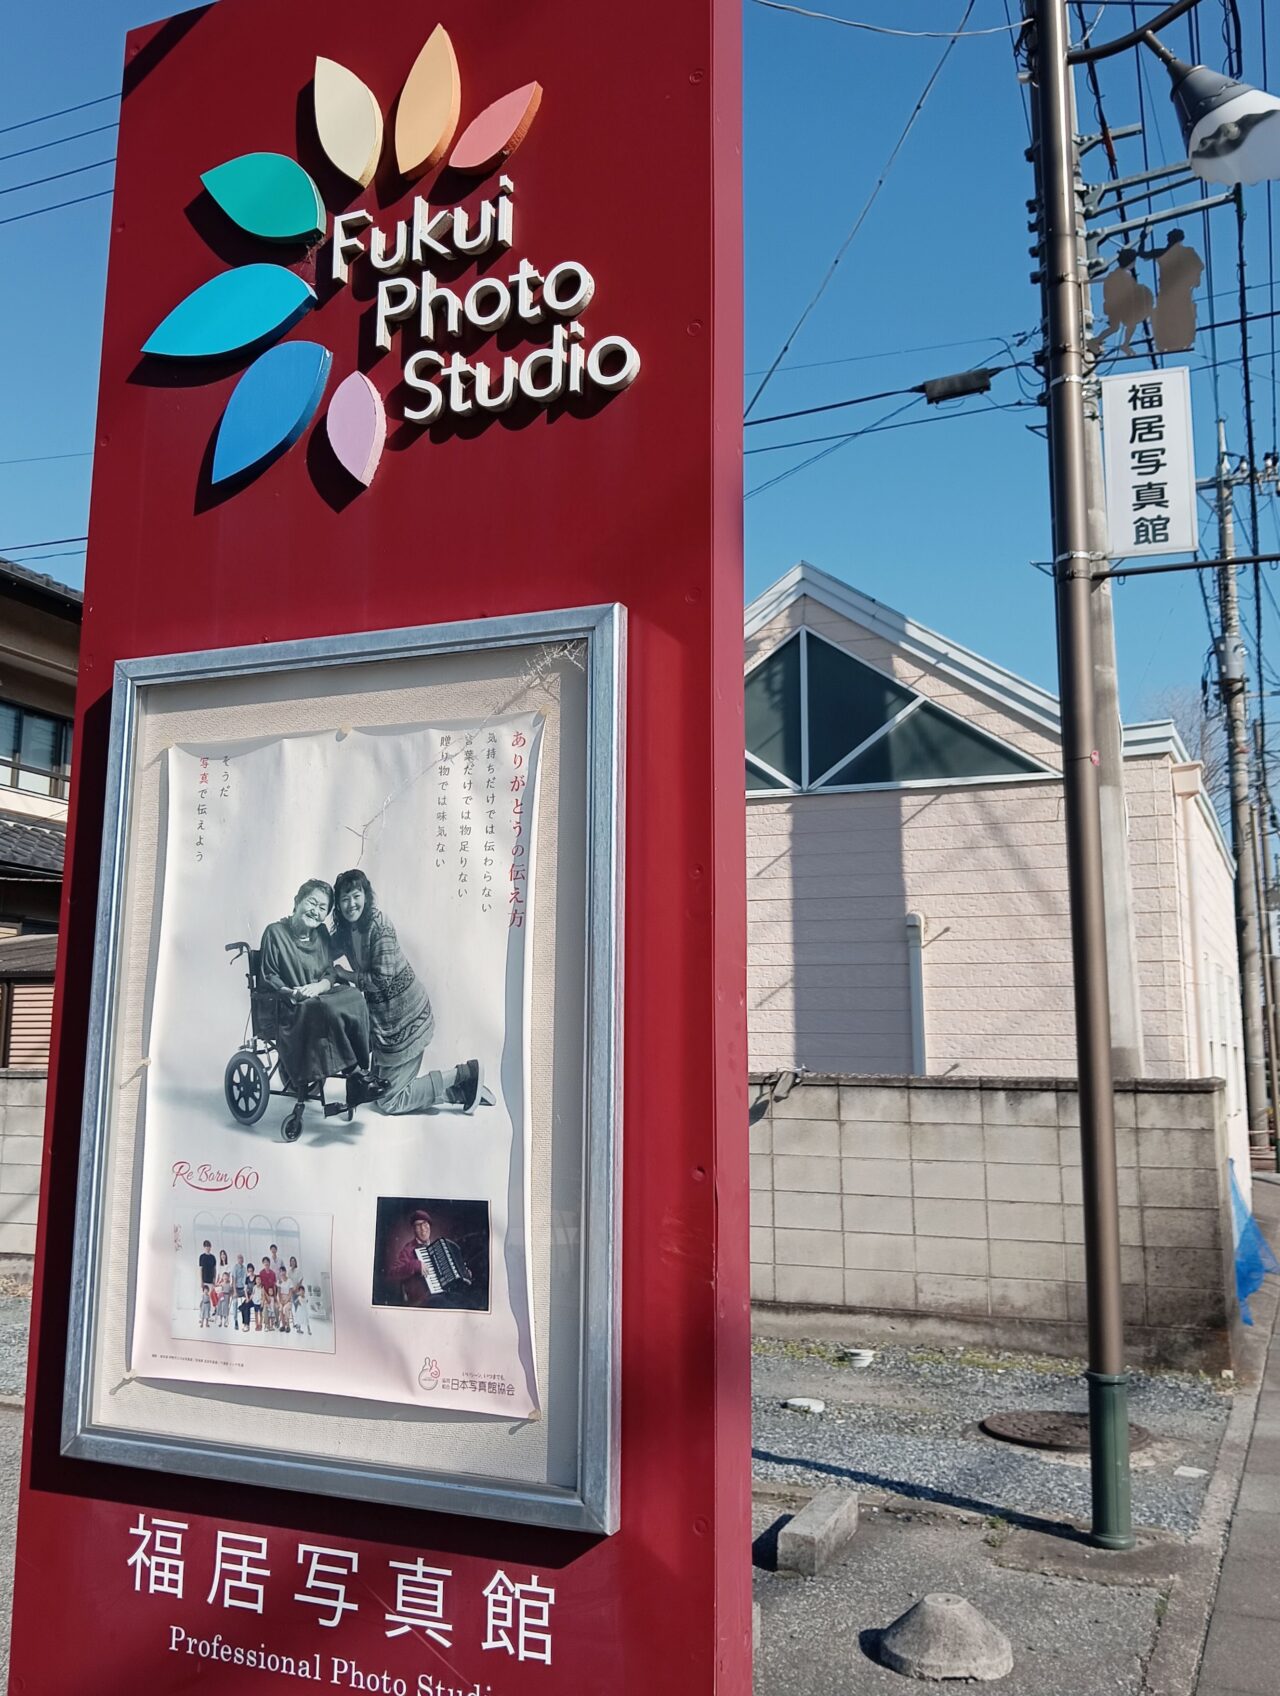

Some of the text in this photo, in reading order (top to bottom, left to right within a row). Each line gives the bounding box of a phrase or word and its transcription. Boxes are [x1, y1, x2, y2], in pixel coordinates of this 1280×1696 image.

[332, 174, 515, 285] Fukui
[375, 257, 596, 353] Photo
[403, 319, 641, 425] Studio
[1127, 381, 1171, 546] 福居写真館
[195, 757, 209, 862] 写真で伝えよう
[219, 755, 231, 798] そうだ
[435, 735, 451, 868] 贈り物では味気ない
[457, 733, 475, 899] 言葉だけでは物足りない
[481, 732, 498, 913] 気持ちだけでは伝わらない
[508, 730, 526, 929] ありがとうの伝え方
[234, 1166, 260, 1190] 60
[450, 1378, 516, 1396] 日本写真館協会
[126, 1512, 556, 1666] 福居写真館
[168, 1625, 322, 1681] Professional
[330, 1657, 408, 1696] Photo
